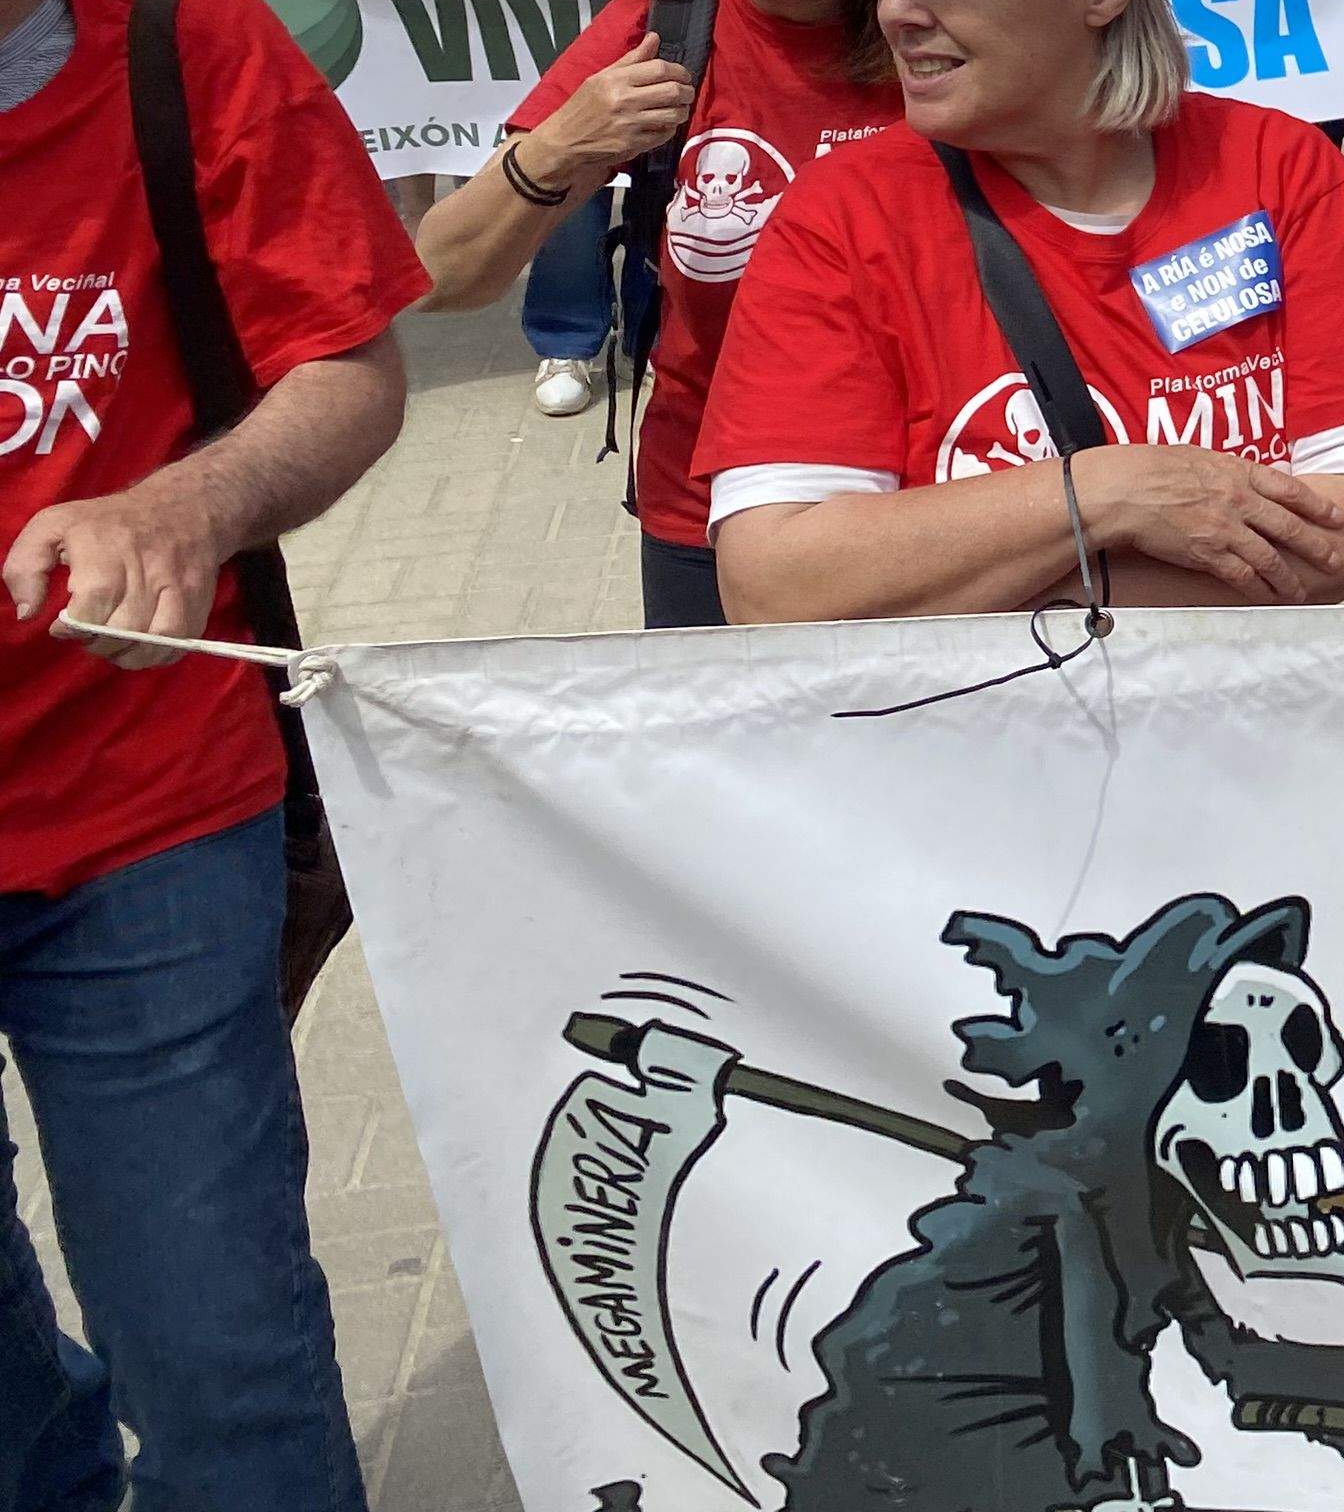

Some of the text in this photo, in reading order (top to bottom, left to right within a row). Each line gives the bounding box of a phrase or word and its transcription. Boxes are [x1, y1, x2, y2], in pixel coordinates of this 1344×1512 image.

[31, 271, 115, 292] Veciñal
[1141, 221, 1274, 295] A RÍA é NOSA
[1170, 257, 1270, 312] e NON de
[1170, 279, 1283, 342] CELULOSA
